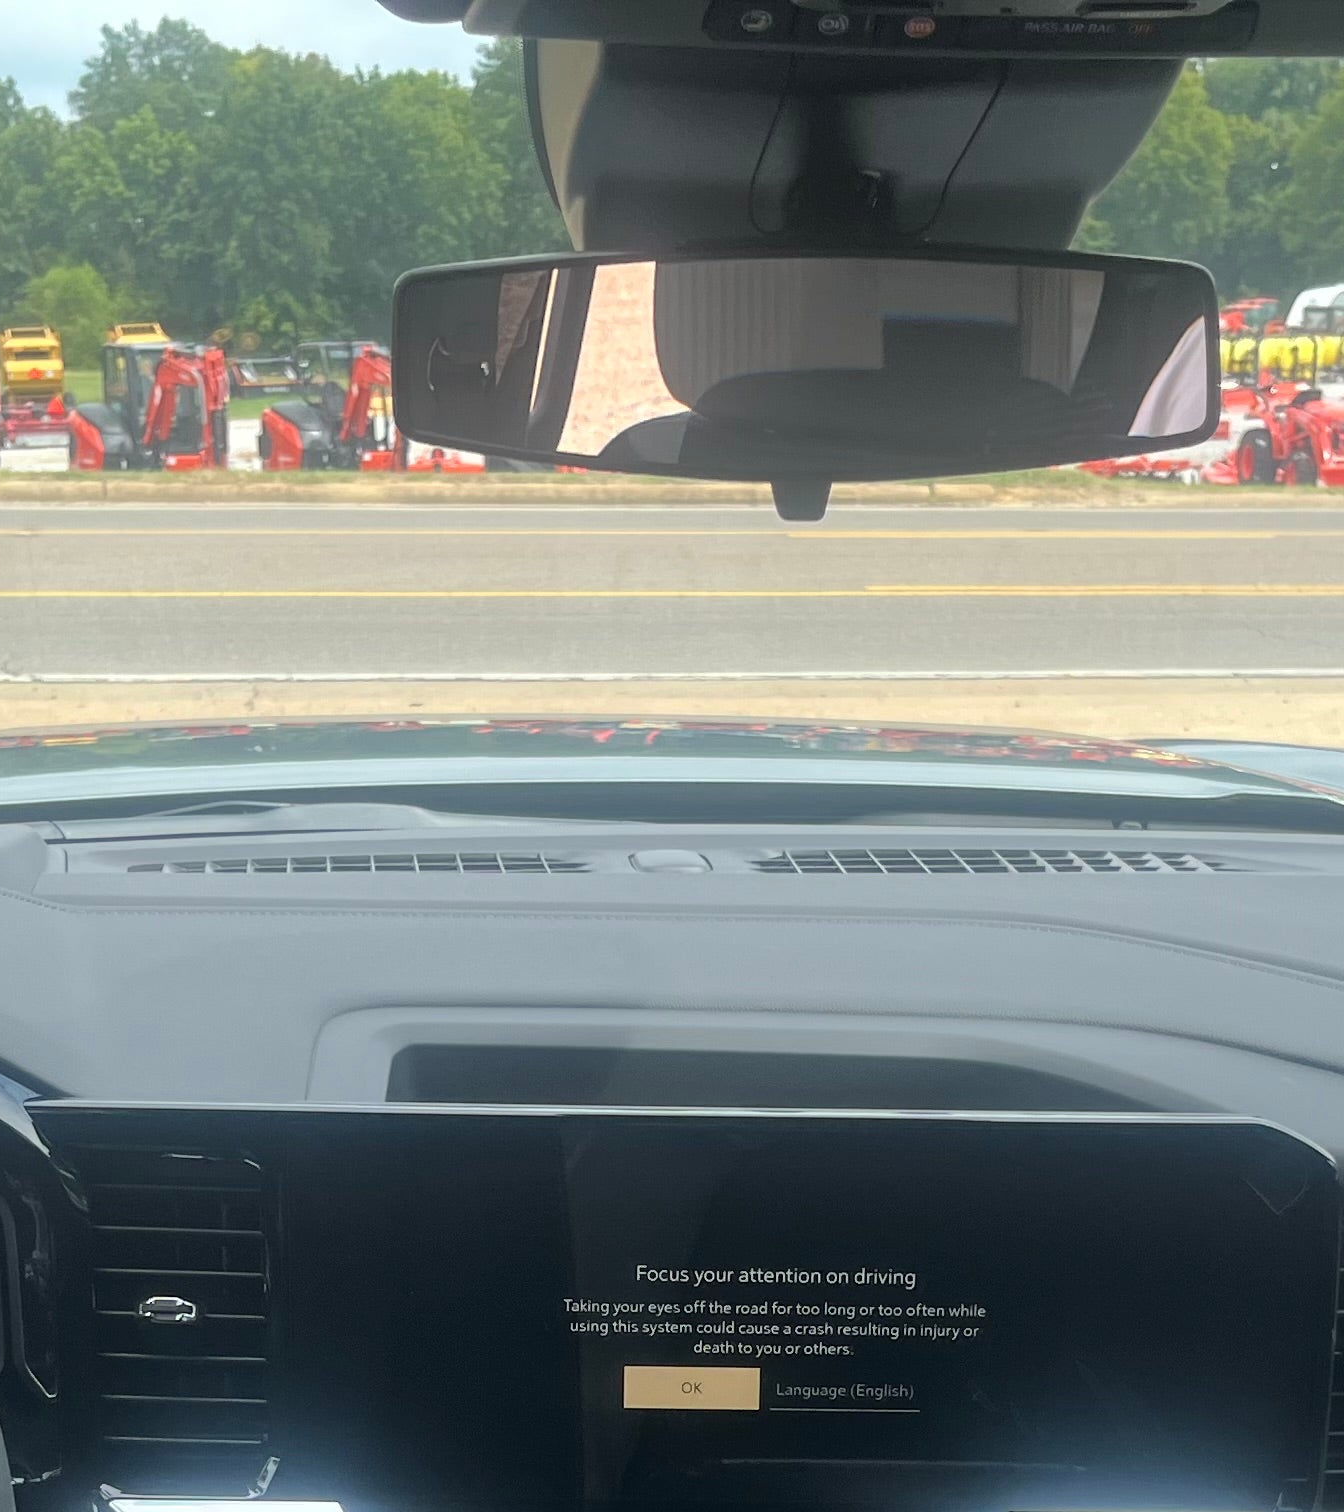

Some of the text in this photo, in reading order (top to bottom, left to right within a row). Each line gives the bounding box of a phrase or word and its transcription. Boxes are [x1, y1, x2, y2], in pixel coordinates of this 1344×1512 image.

[1063, 22, 1086, 34] AIR
[636, 1266, 916, 1289] Focus your attention on driving
[564, 1299, 986, 1319] Taking your eyes off the road for too long or too often while
[570, 1319, 979, 1340] using this system could cause a crash resulting in injury or
[693, 1341, 854, 1359] death to you or others.
[681, 1381, 703, 1394] OK
[776, 1384, 914, 1400] Language (English)
